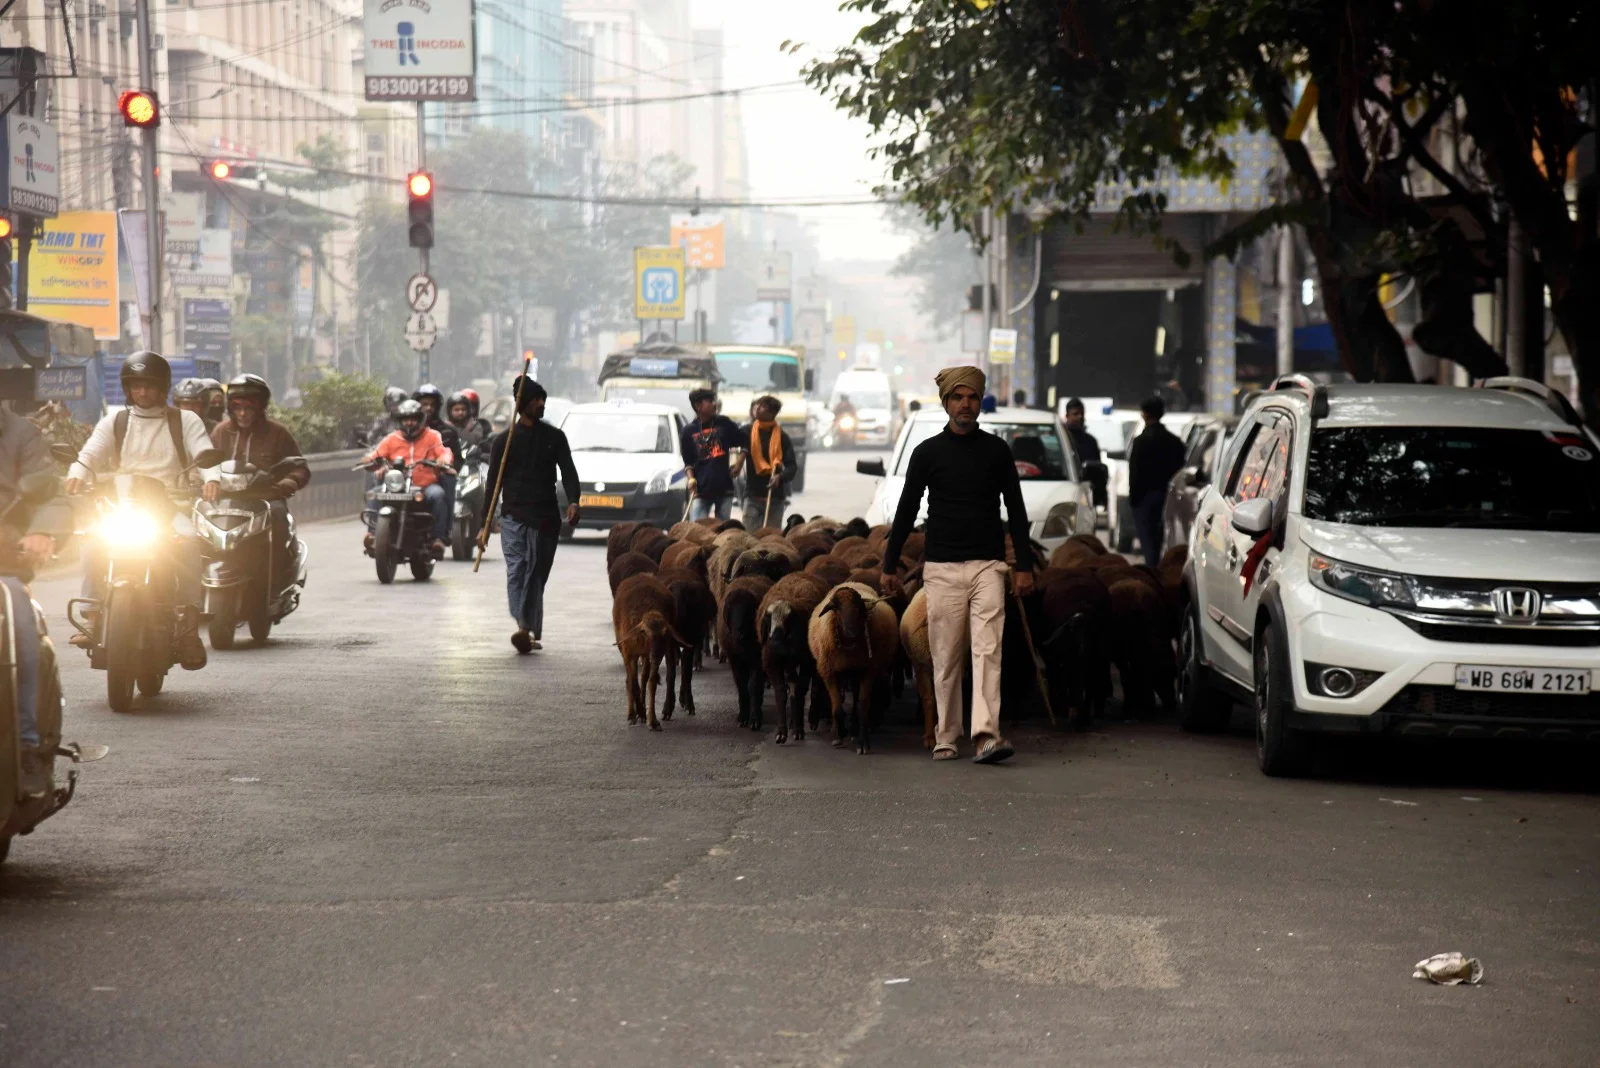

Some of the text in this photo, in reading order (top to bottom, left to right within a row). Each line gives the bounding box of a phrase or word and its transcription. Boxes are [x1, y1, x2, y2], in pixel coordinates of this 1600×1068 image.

[368, 78, 469, 96] 9830012199
[13, 190, 57, 213] 9830012199
[80, 233, 105, 249] TMT
[1471, 670, 1493, 688] WB
[1542, 673, 1585, 691] 2121
